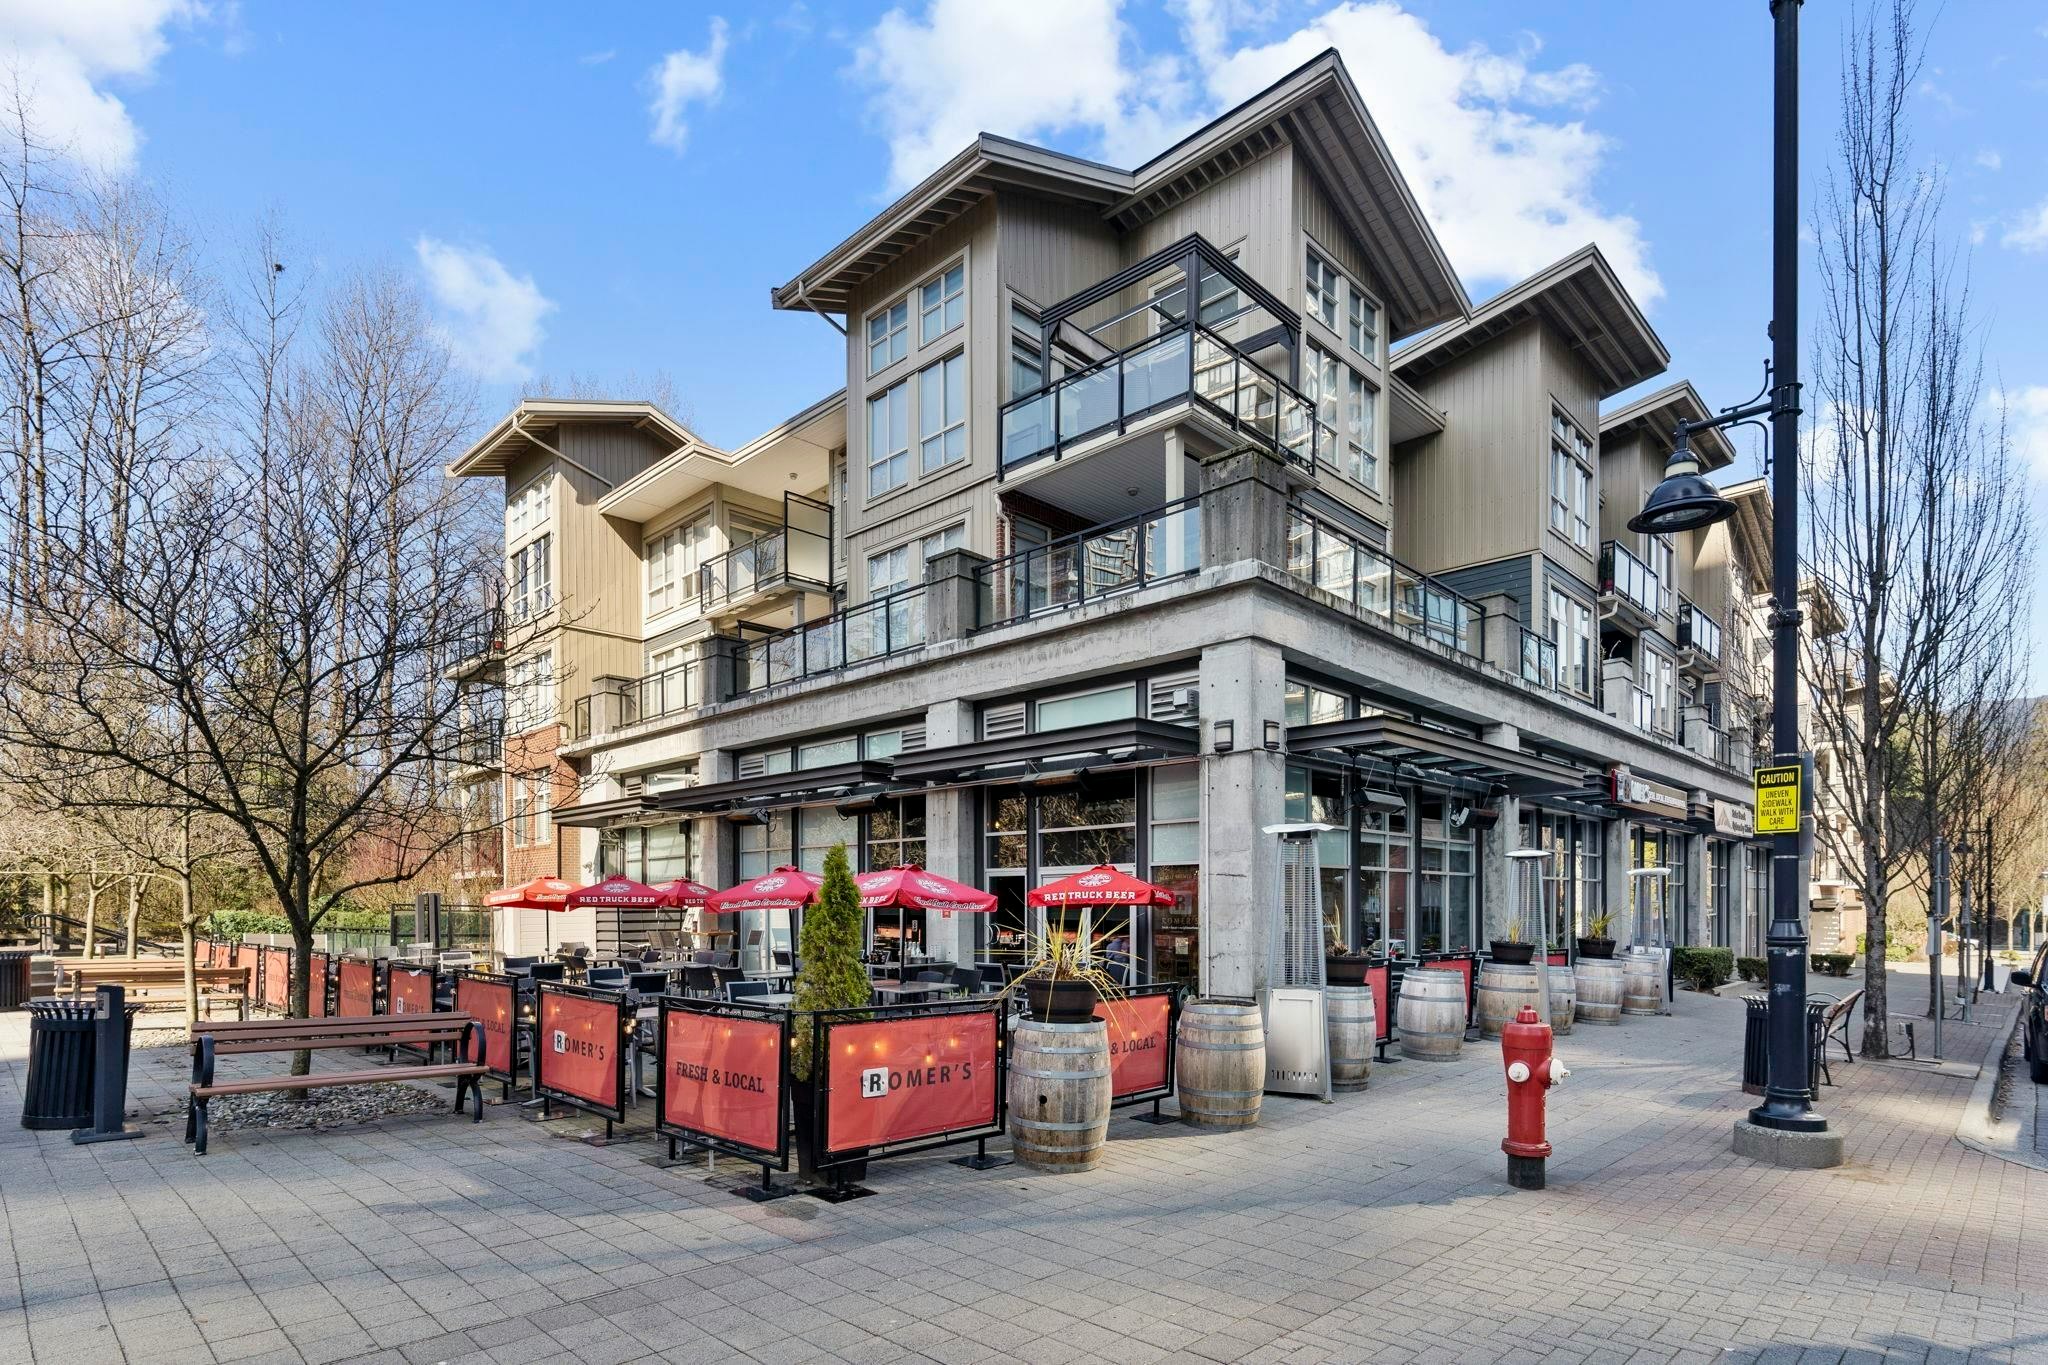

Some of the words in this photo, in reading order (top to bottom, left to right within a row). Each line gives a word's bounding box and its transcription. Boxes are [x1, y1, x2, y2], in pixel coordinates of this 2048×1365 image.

[1760, 772, 1795, 785] CAUTION
[1765, 789, 1789, 799] UNEVEN
[1761, 798, 1793, 808] SIDEWALK
[1760, 808, 1777, 817] WALK
[1778, 807, 1794, 816] WITH
[1769, 817, 1785, 825] CARE
[1044, 892, 1065, 901] RED
[1068, 891, 1103, 900] TRUCK
[1105, 891, 1136, 899] BEER
[487, 1019, 505, 1034] LOCAL
[556, 1034, 605, 1061] ROMER'S
[1110, 1042, 1119, 1055] &
[1122, 1036, 1156, 1053] LOCAL
[676, 1061, 708, 1082] FRESH
[712, 1069, 720, 1085] &
[724, 1071, 765, 1093] LOCAL
[869, 1062, 972, 1092] ROMER'S
